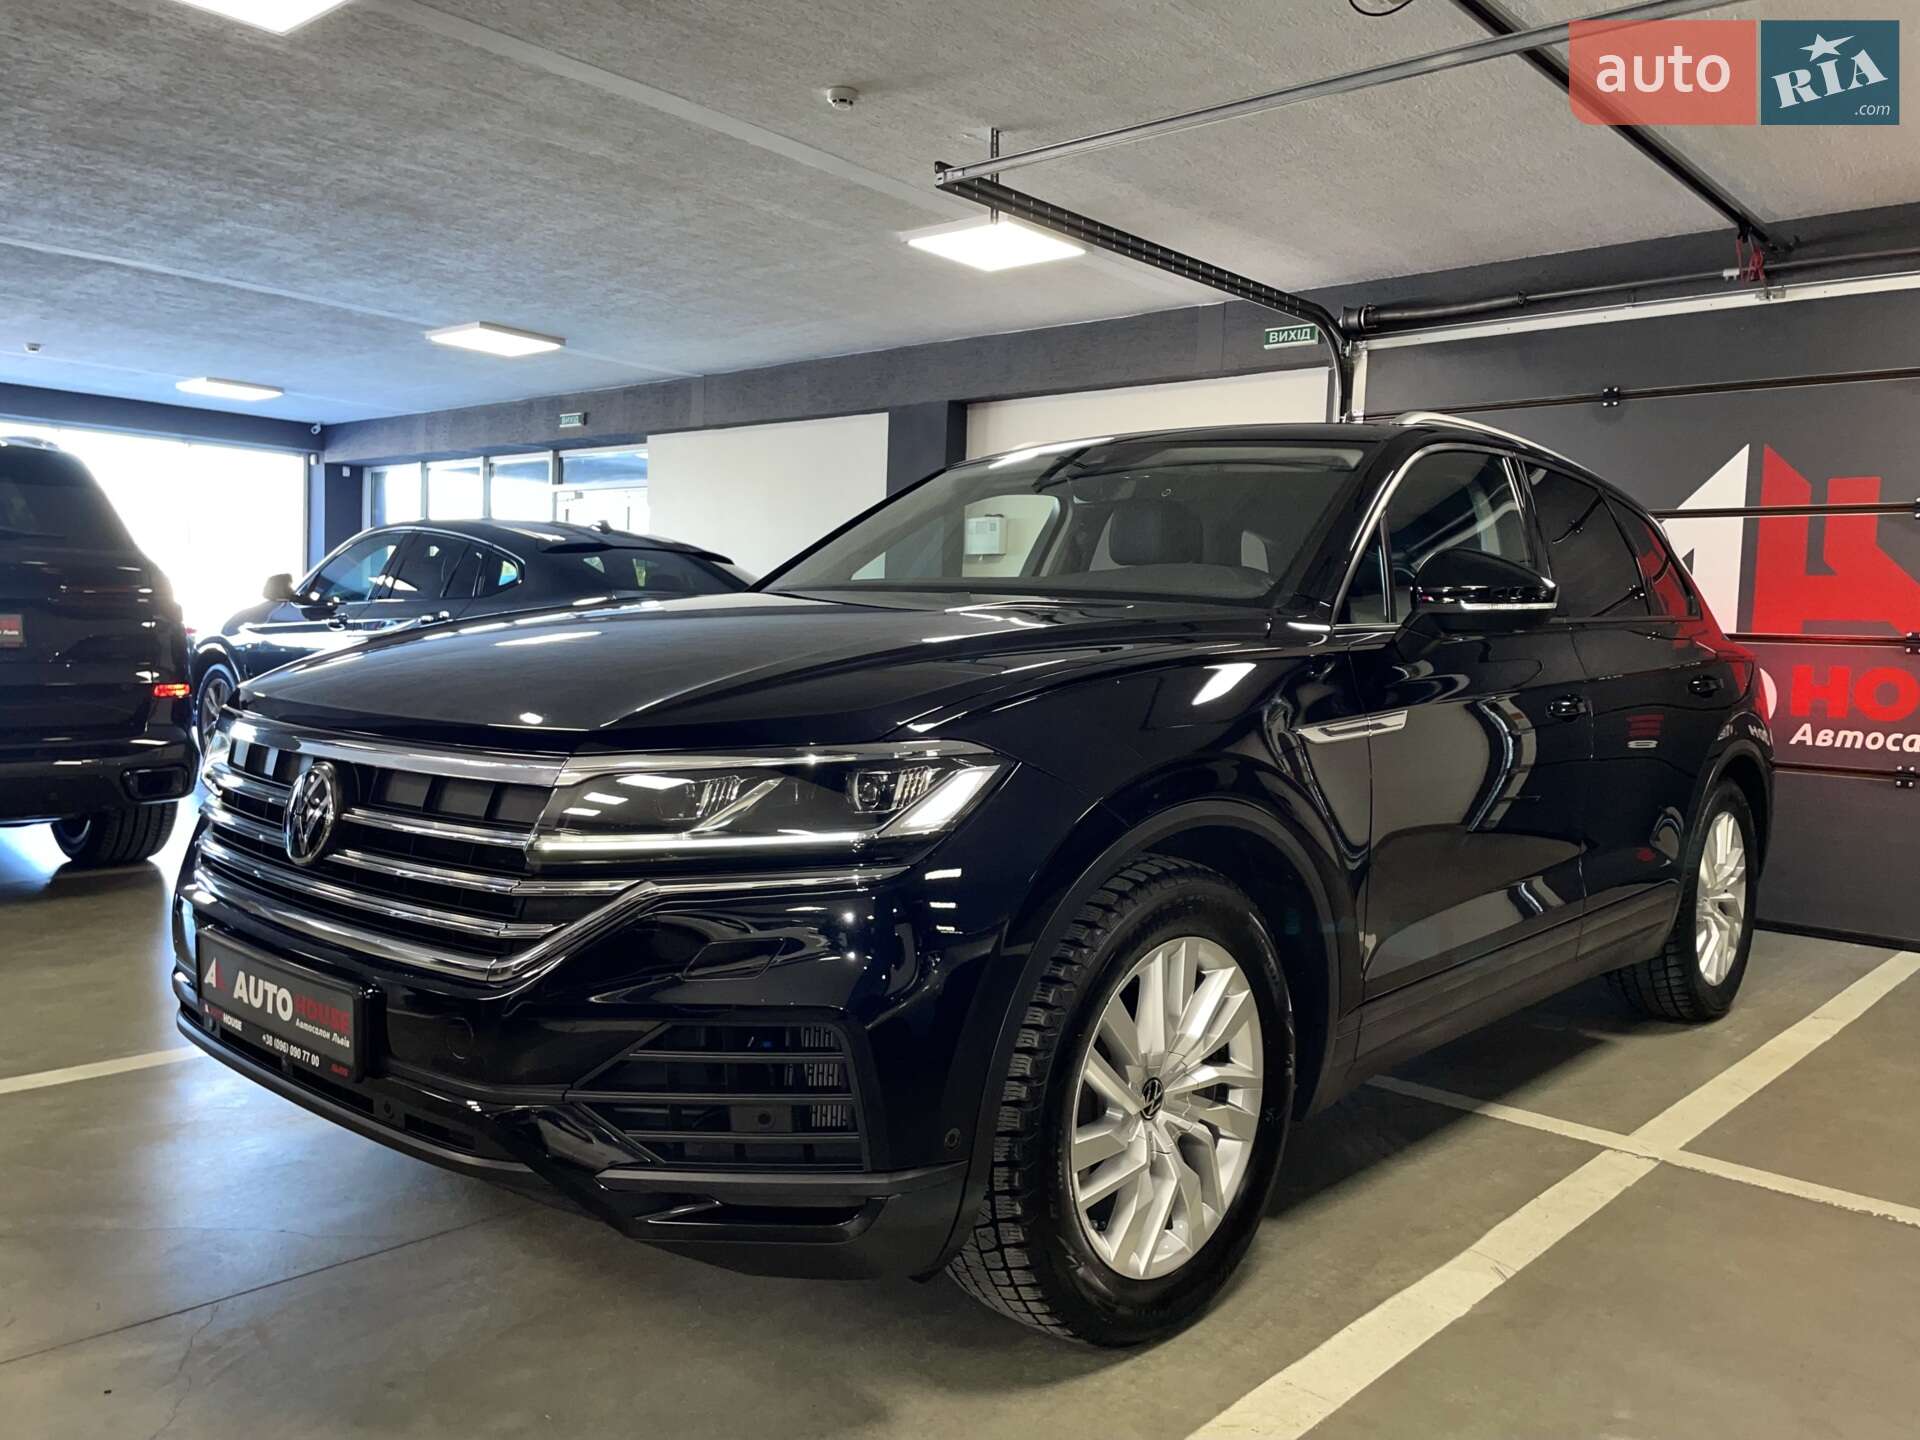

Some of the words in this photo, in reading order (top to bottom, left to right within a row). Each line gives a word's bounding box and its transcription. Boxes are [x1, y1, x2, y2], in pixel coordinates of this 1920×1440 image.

[1269, 328, 1311, 343] ВИХІД
[302, 1050, 311, 1063] 77
[311, 1053, 320, 1068] 00
